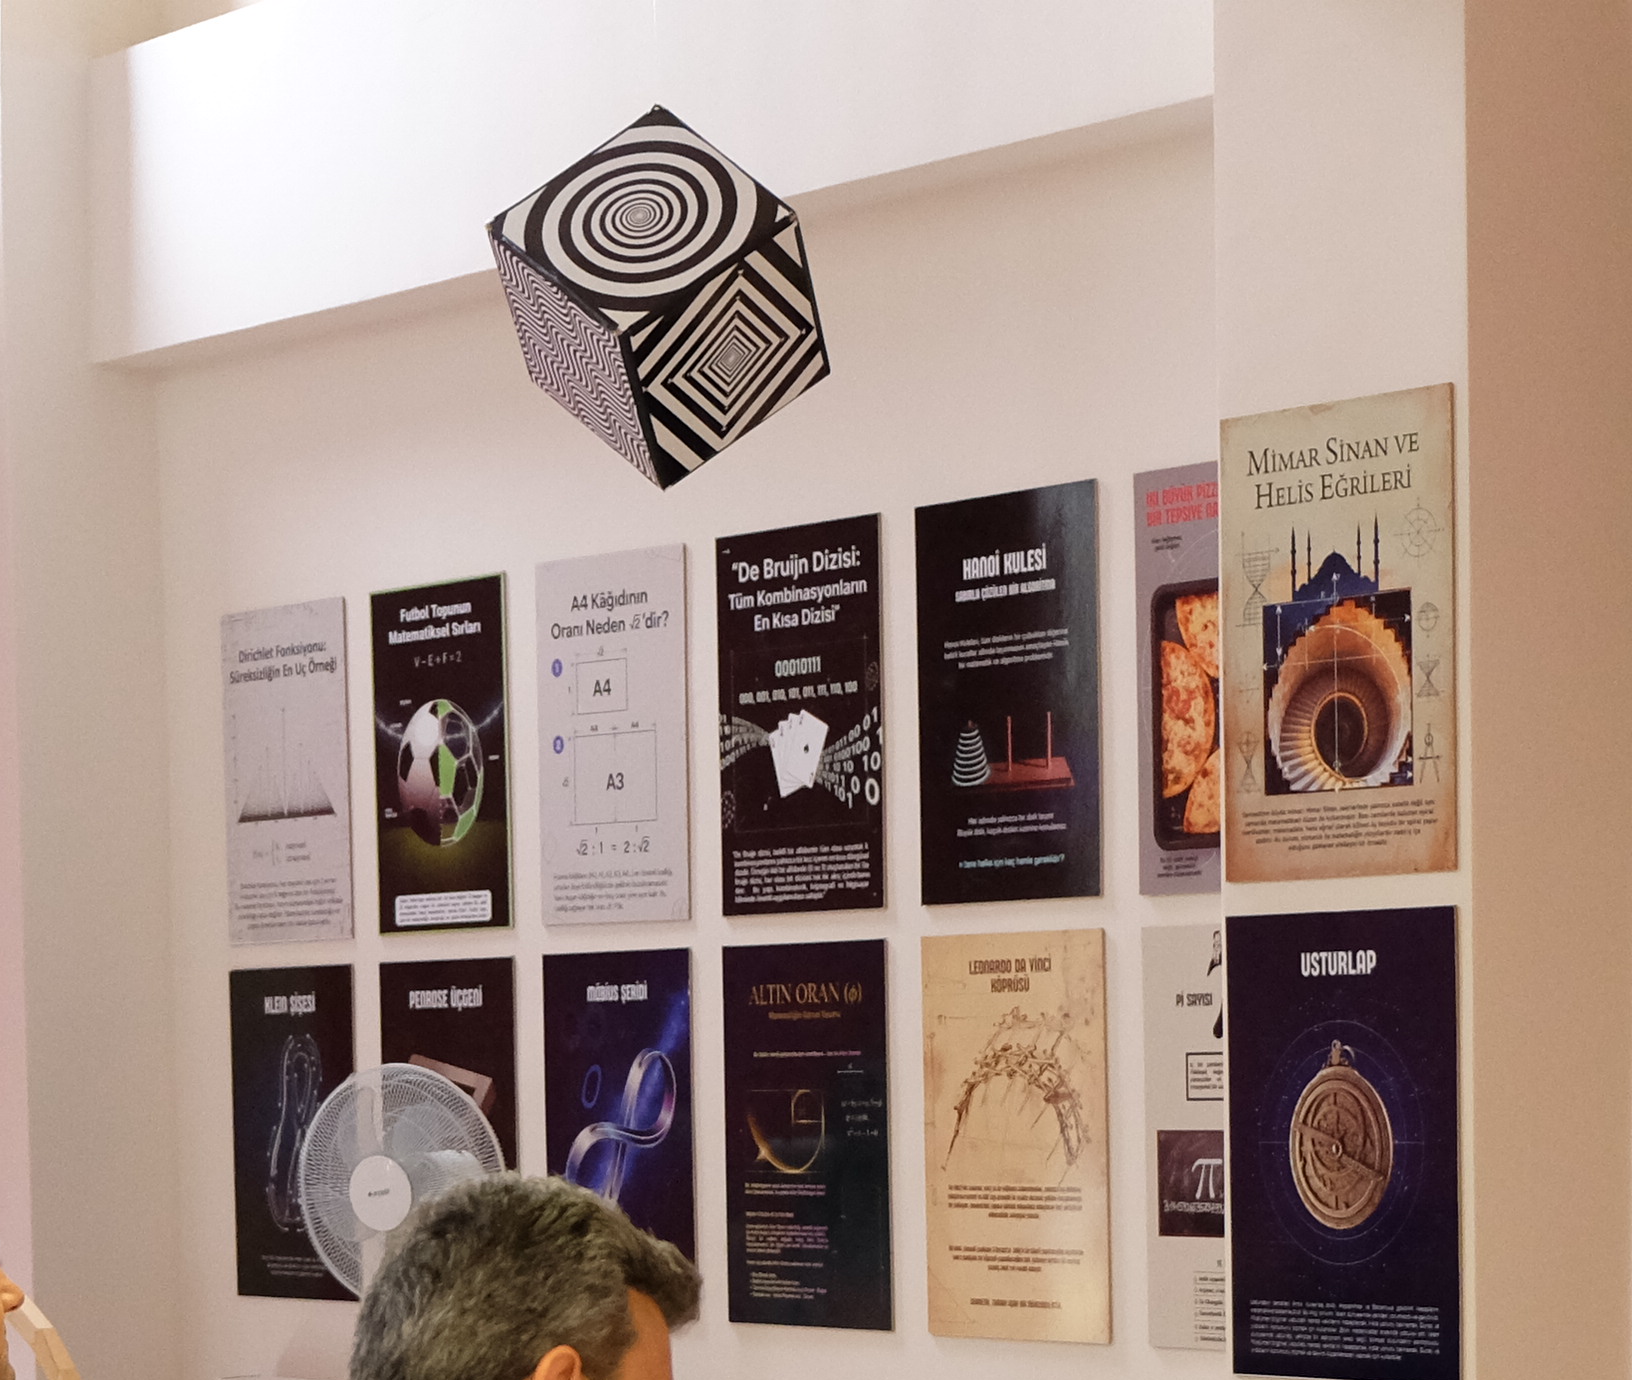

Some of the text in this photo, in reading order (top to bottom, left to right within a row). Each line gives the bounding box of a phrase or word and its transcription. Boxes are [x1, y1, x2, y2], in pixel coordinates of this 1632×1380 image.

[1246, 432, 1420, 477] MİMAR SİNAN VE
[1254, 478, 1314, 510] HELİS
[1319, 463, 1412, 502] EĞRİLERİ
[762, 553, 809, 581] Bruijn
[812, 545, 861, 572] Dizisi:
[1003, 542, 1047, 575] KULESİ
[570, 588, 649, 612] A4 Kâğıdının
[728, 577, 868, 611] Tüm Kombinasyonların
[399, 602, 472, 623] Futbol Topunun
[753, 614, 770, 632] En
[772, 611, 799, 629] Kısa
[388, 620, 482, 645] Matematiksel Sırları
[550, 622, 583, 640] Oranı
[586, 616, 626, 636] Neden
[282, 663, 293, 677] En
[295, 662, 307, 677] Uç
[592, 678, 612, 697] A4
[606, 772, 625, 791] A3
[1015, 957, 1027, 973] DA
[1300, 949, 1377, 978] USTURLAP
[748, 983, 792, 1006] ALTIN
[795, 981, 840, 1004] ORAN
